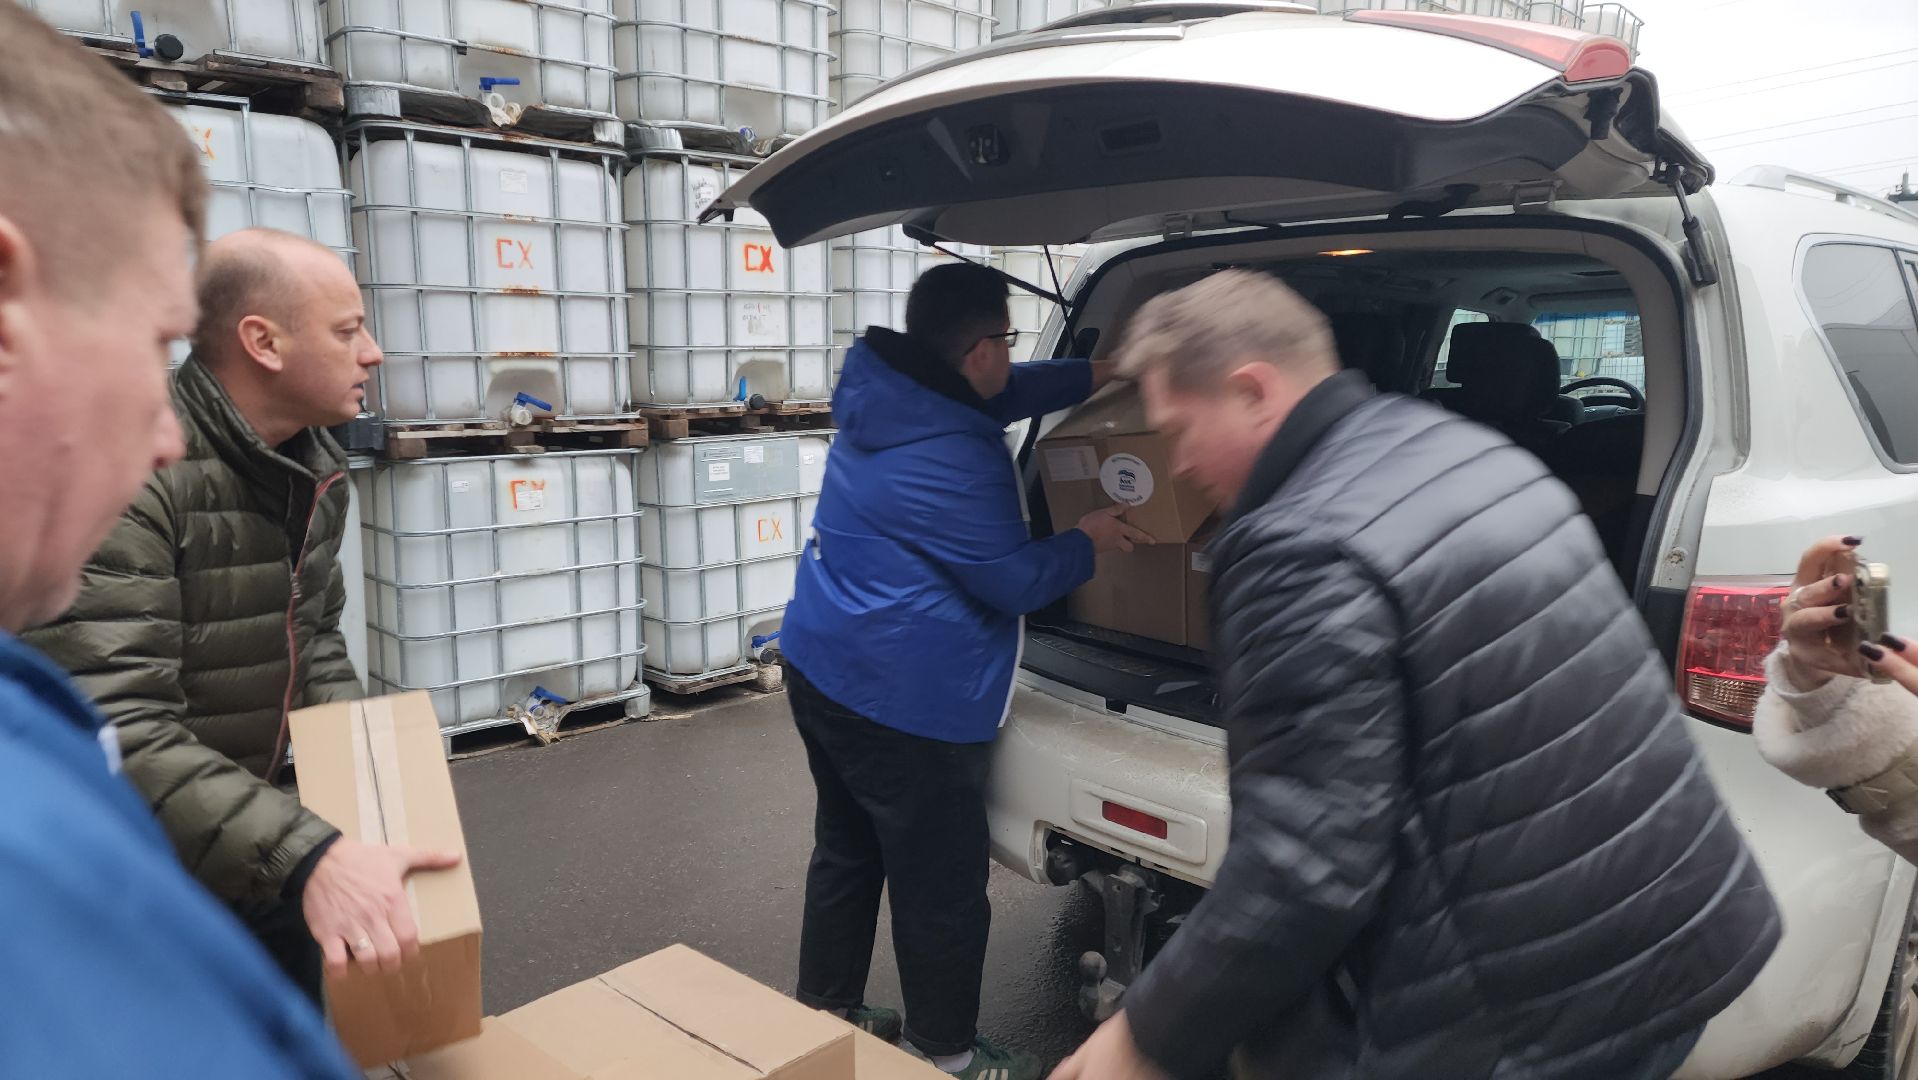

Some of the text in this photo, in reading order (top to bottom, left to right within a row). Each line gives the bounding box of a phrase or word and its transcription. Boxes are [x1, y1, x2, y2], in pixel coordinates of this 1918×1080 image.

[496, 238, 534, 269] CX
[743, 244, 774, 273] CX
[757, 518, 783, 542] CX
